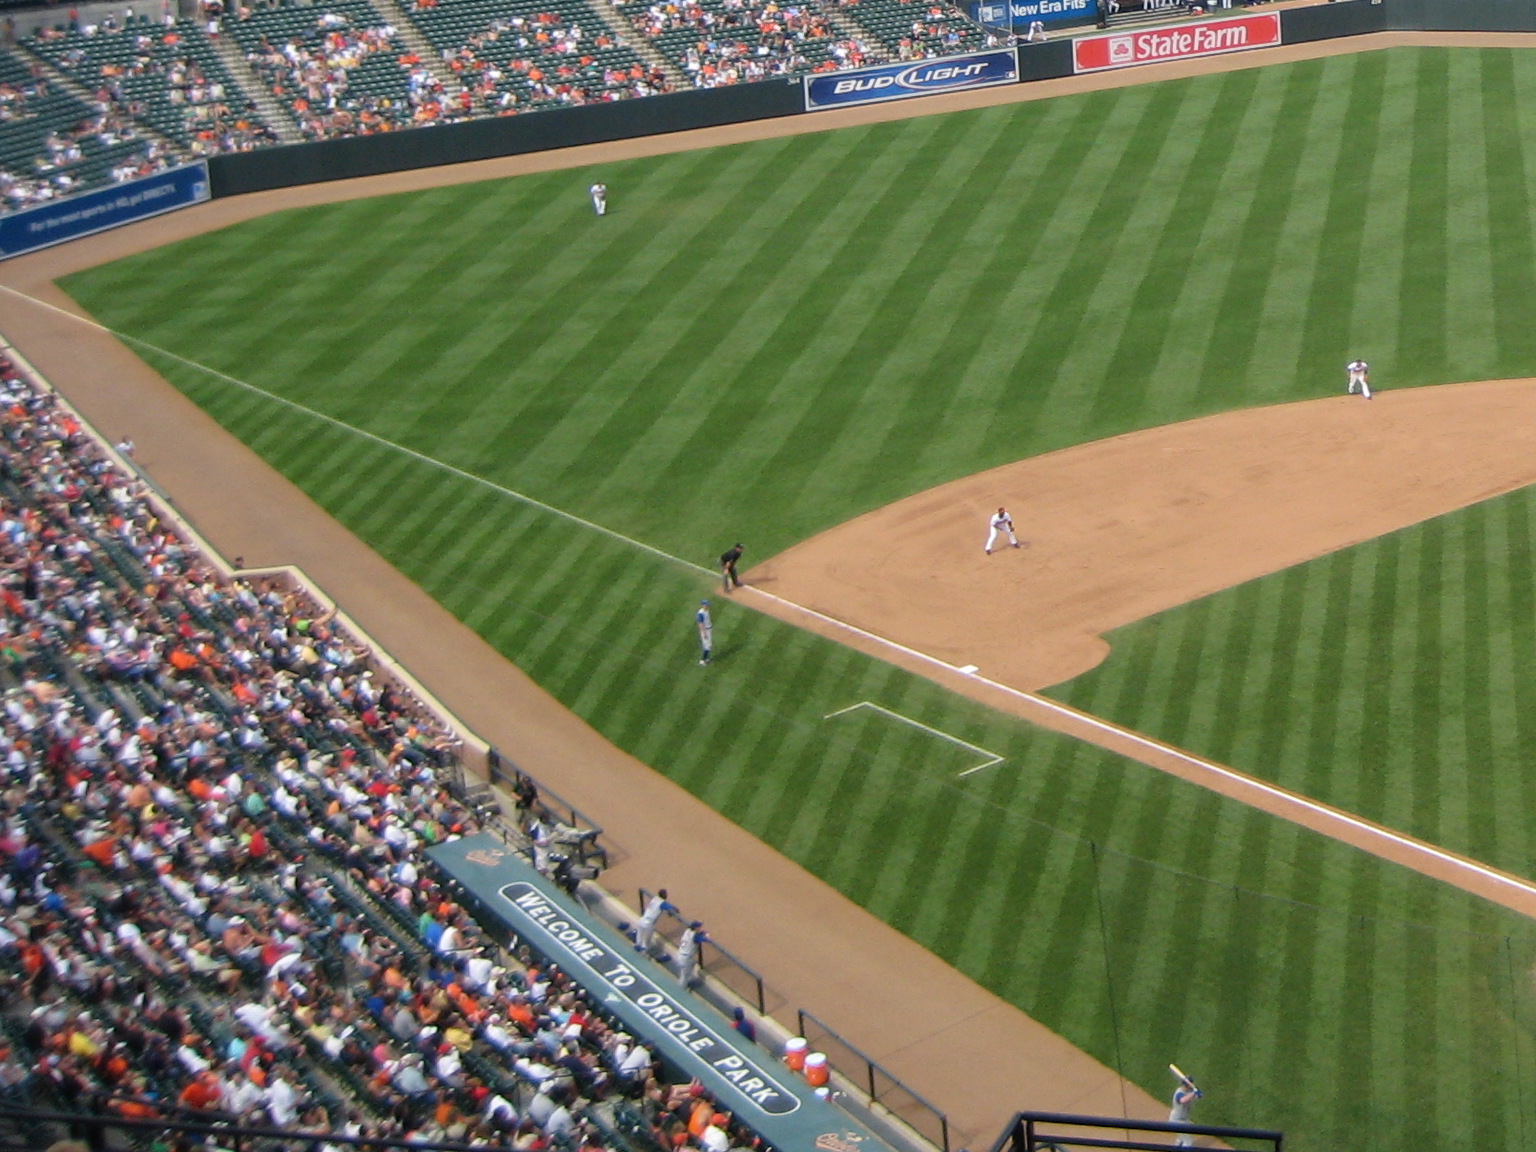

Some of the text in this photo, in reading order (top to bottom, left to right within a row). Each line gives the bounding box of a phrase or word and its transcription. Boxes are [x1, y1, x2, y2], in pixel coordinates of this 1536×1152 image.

[1010, 4, 1038, 17] New
[1040, 1, 1061, 14] Era
[834, 63, 988, 94] BUD LIGHT
[515, 892, 779, 1103] WELCOME TO ORIOLE PARK
